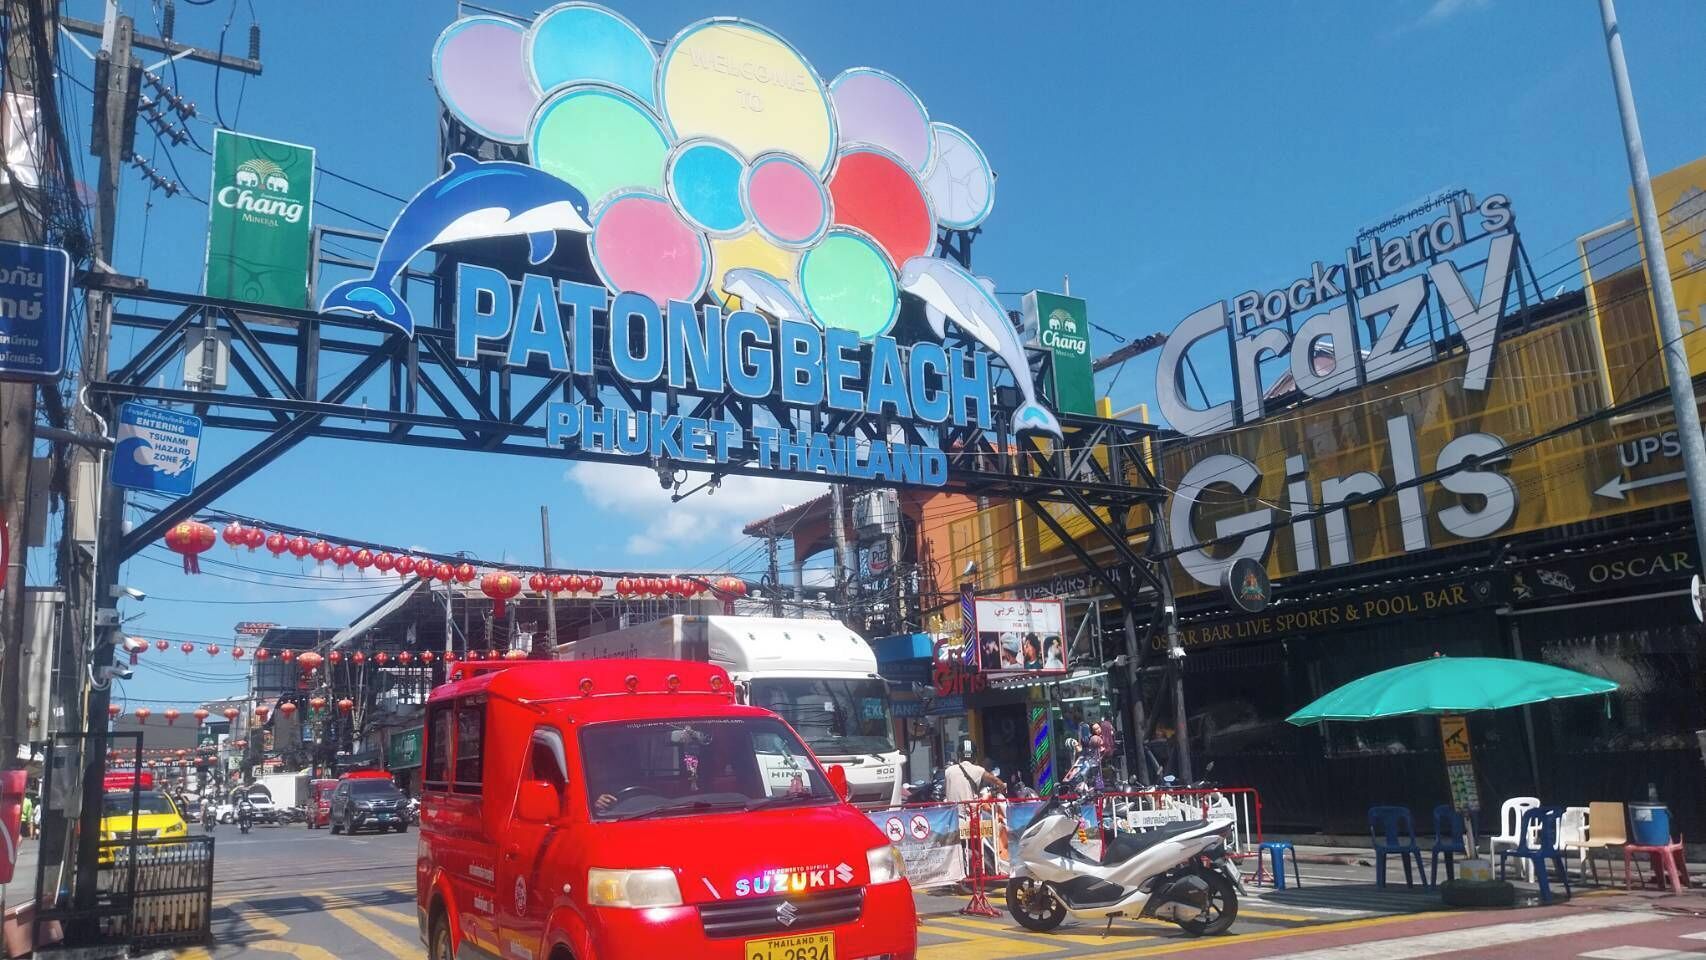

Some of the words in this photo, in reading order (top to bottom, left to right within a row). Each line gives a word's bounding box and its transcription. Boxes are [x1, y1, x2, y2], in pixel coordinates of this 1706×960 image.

[688, 46, 806, 92] WELCOME
[735, 88, 765, 112] TO
[218, 186, 304, 223] Chang
[1233, 261, 1345, 333] Rock
[1346, 193, 1513, 287] Hard's
[1042, 330, 1086, 354] Chang
[1155, 231, 1517, 439] Crazy
[136, 417, 185, 433] ENTERING
[149, 432, 189, 445] TSUNAMI
[153, 453, 178, 463] ZONE
[154, 443, 191, 456] HAZARD
[546, 400, 736, 464] PHUKET
[751, 426, 948, 487] THAILAND
[1170, 414, 1518, 587] Girls
[1589, 552, 1695, 583] OSCAR
[1152, 630, 1199, 651] OSAR
[1202, 623, 1233, 643] BAR
[1236, 616, 1271, 637] LIVE
[1276, 602, 1340, 632] SPORTS
[1345, 603, 1361, 622] &
[1366, 594, 1420, 619] POOL
[1424, 585, 1468, 610] BAR
[735, 869, 835, 897] SUZUKI
[768, 937, 815, 949] THAILAND
